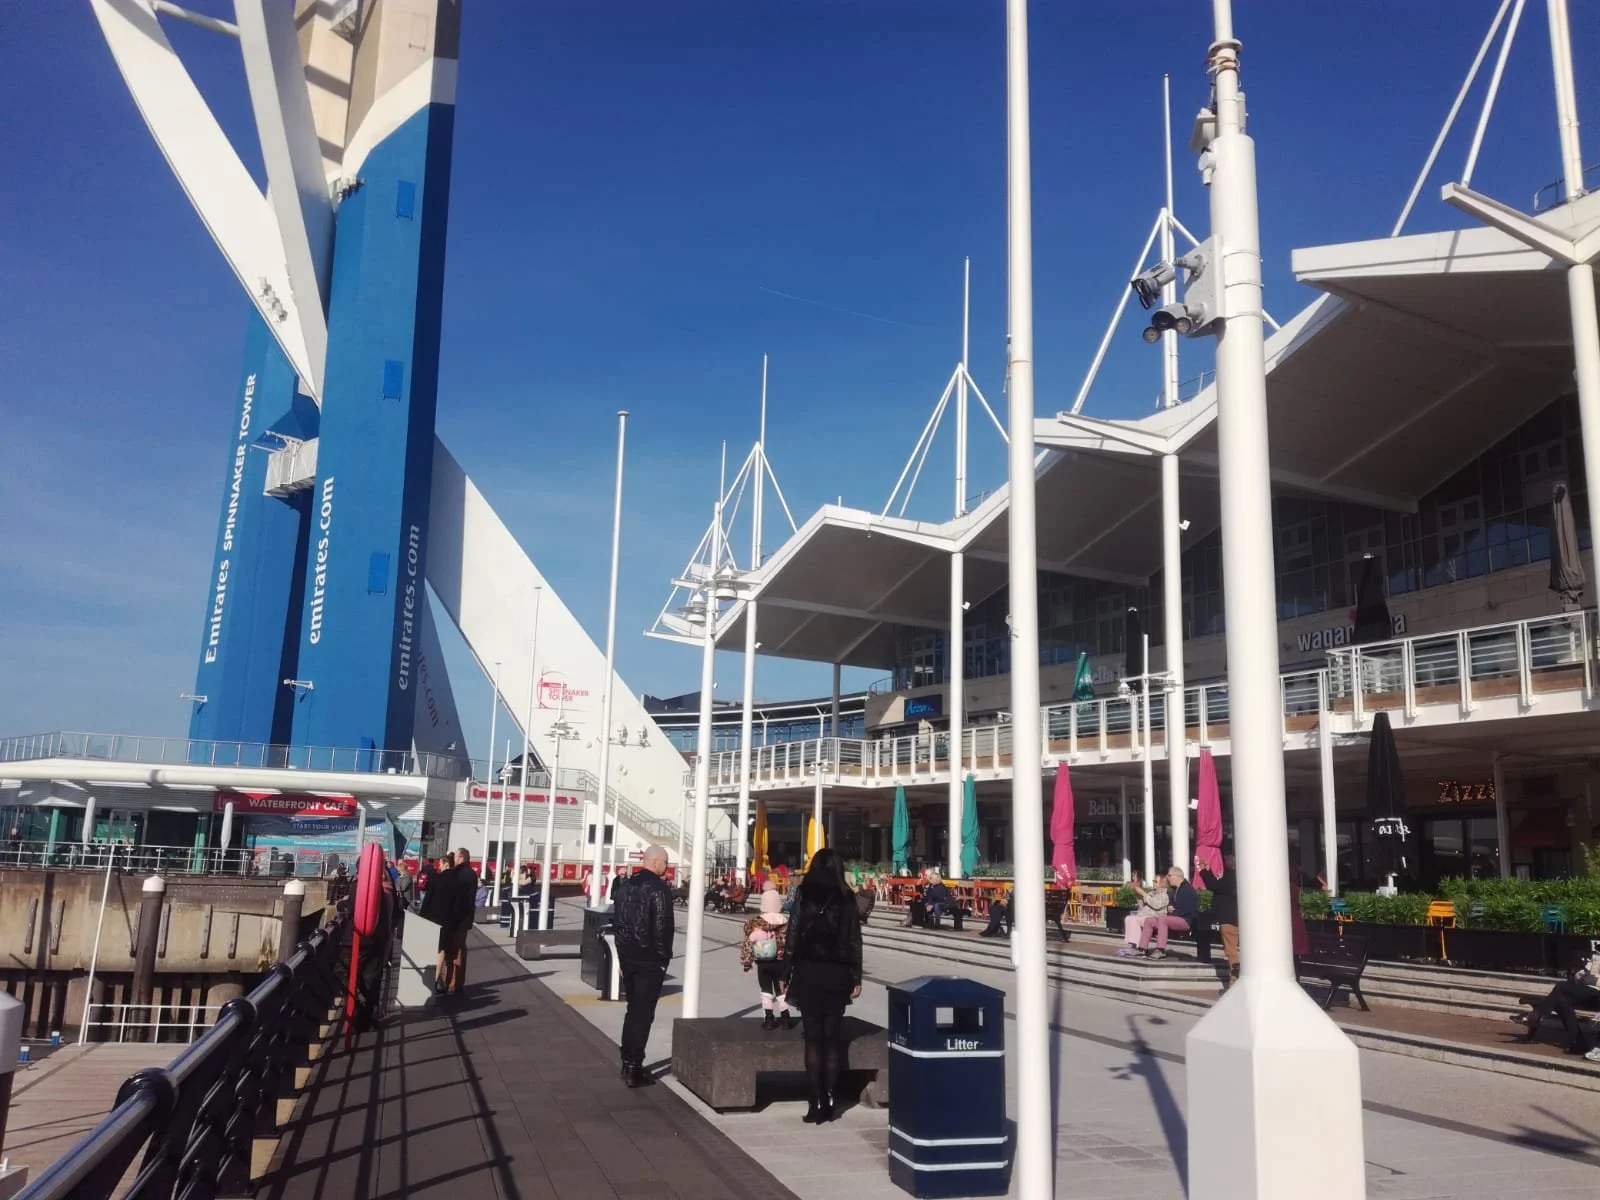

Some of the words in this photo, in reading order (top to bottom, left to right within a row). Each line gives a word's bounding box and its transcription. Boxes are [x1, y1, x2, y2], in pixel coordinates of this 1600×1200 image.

[205, 560, 230, 664] Emirates
[223, 444, 247, 551] SPINNAKER
[238, 373, 257, 441] TOWER
[309, 476, 335, 645] emirates.com
[398, 524, 421, 691] emirates.com
[1438, 778, 1497, 803] Zizzi
[249, 798, 321, 811] WATERFRONT
[323, 799, 349, 811] CAFÉ
[1088, 799, 1116, 816] Bella
[946, 1038, 979, 1050] Litter
